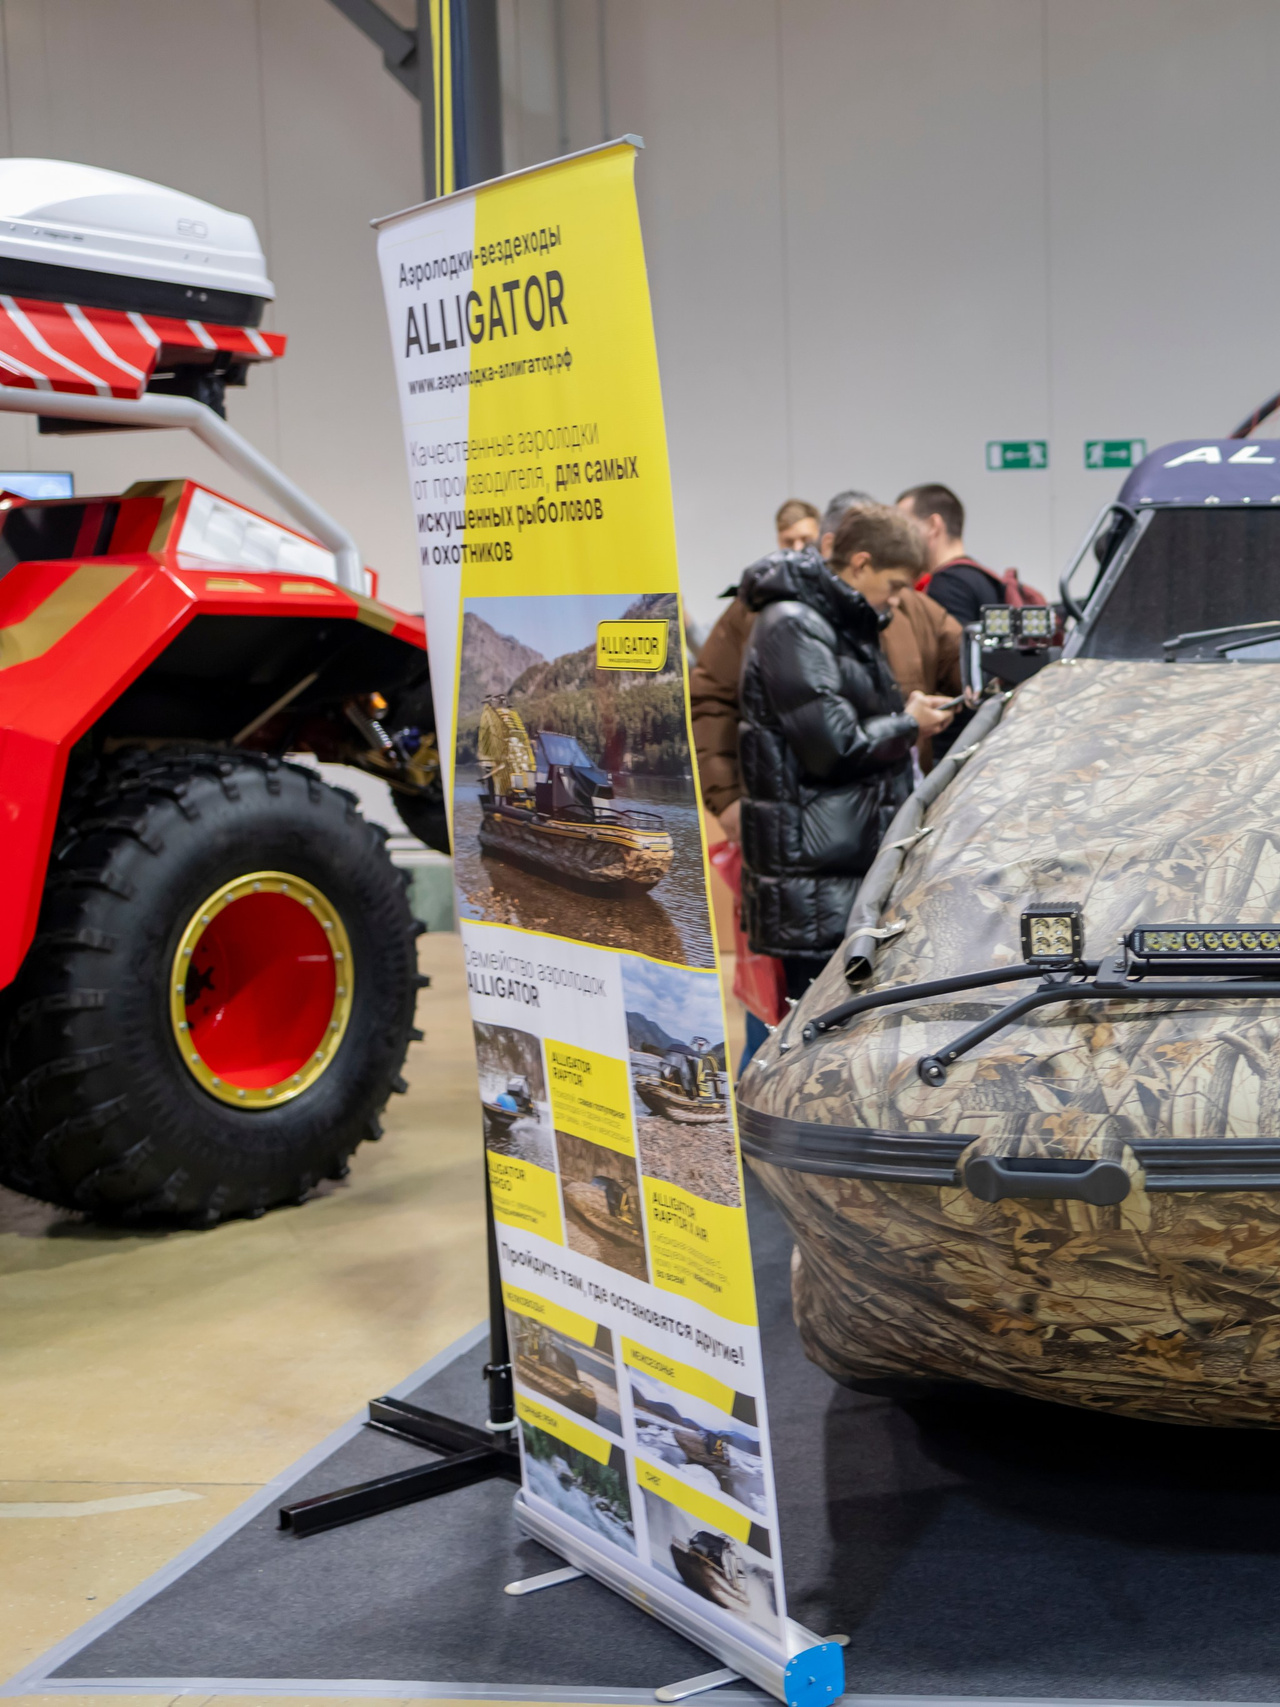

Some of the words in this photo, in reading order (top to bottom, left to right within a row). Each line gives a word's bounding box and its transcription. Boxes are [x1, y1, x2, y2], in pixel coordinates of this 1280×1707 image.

[399, 225, 562, 290] Аэролодки-вездеходы
[405, 270, 568, 358] ALLIGATOR
[410, 432, 515, 468] Качественные
[517, 422, 600, 460] аэролодки
[413, 479, 428, 501] от
[432, 466, 550, 505] производителя,
[555, 461, 582, 492] для
[584, 455, 640, 483] самых
[417, 504, 515, 538] искушенных
[516, 496, 604, 533] рыболовов
[421, 546, 430, 566] и
[432, 541, 513, 566] охотников
[600, 636, 660, 655] ALLIGATOR
[467, 971, 541, 1008] ALLIGATOR
[537, 963, 608, 998] аэролодок
[501, 1241, 559, 1280] Пройдите
[560, 1270, 588, 1297] там,
[588, 1281, 608, 1304] где
[609, 1292, 693, 1340] остановятся
[695, 1328, 745, 1367] другие!
